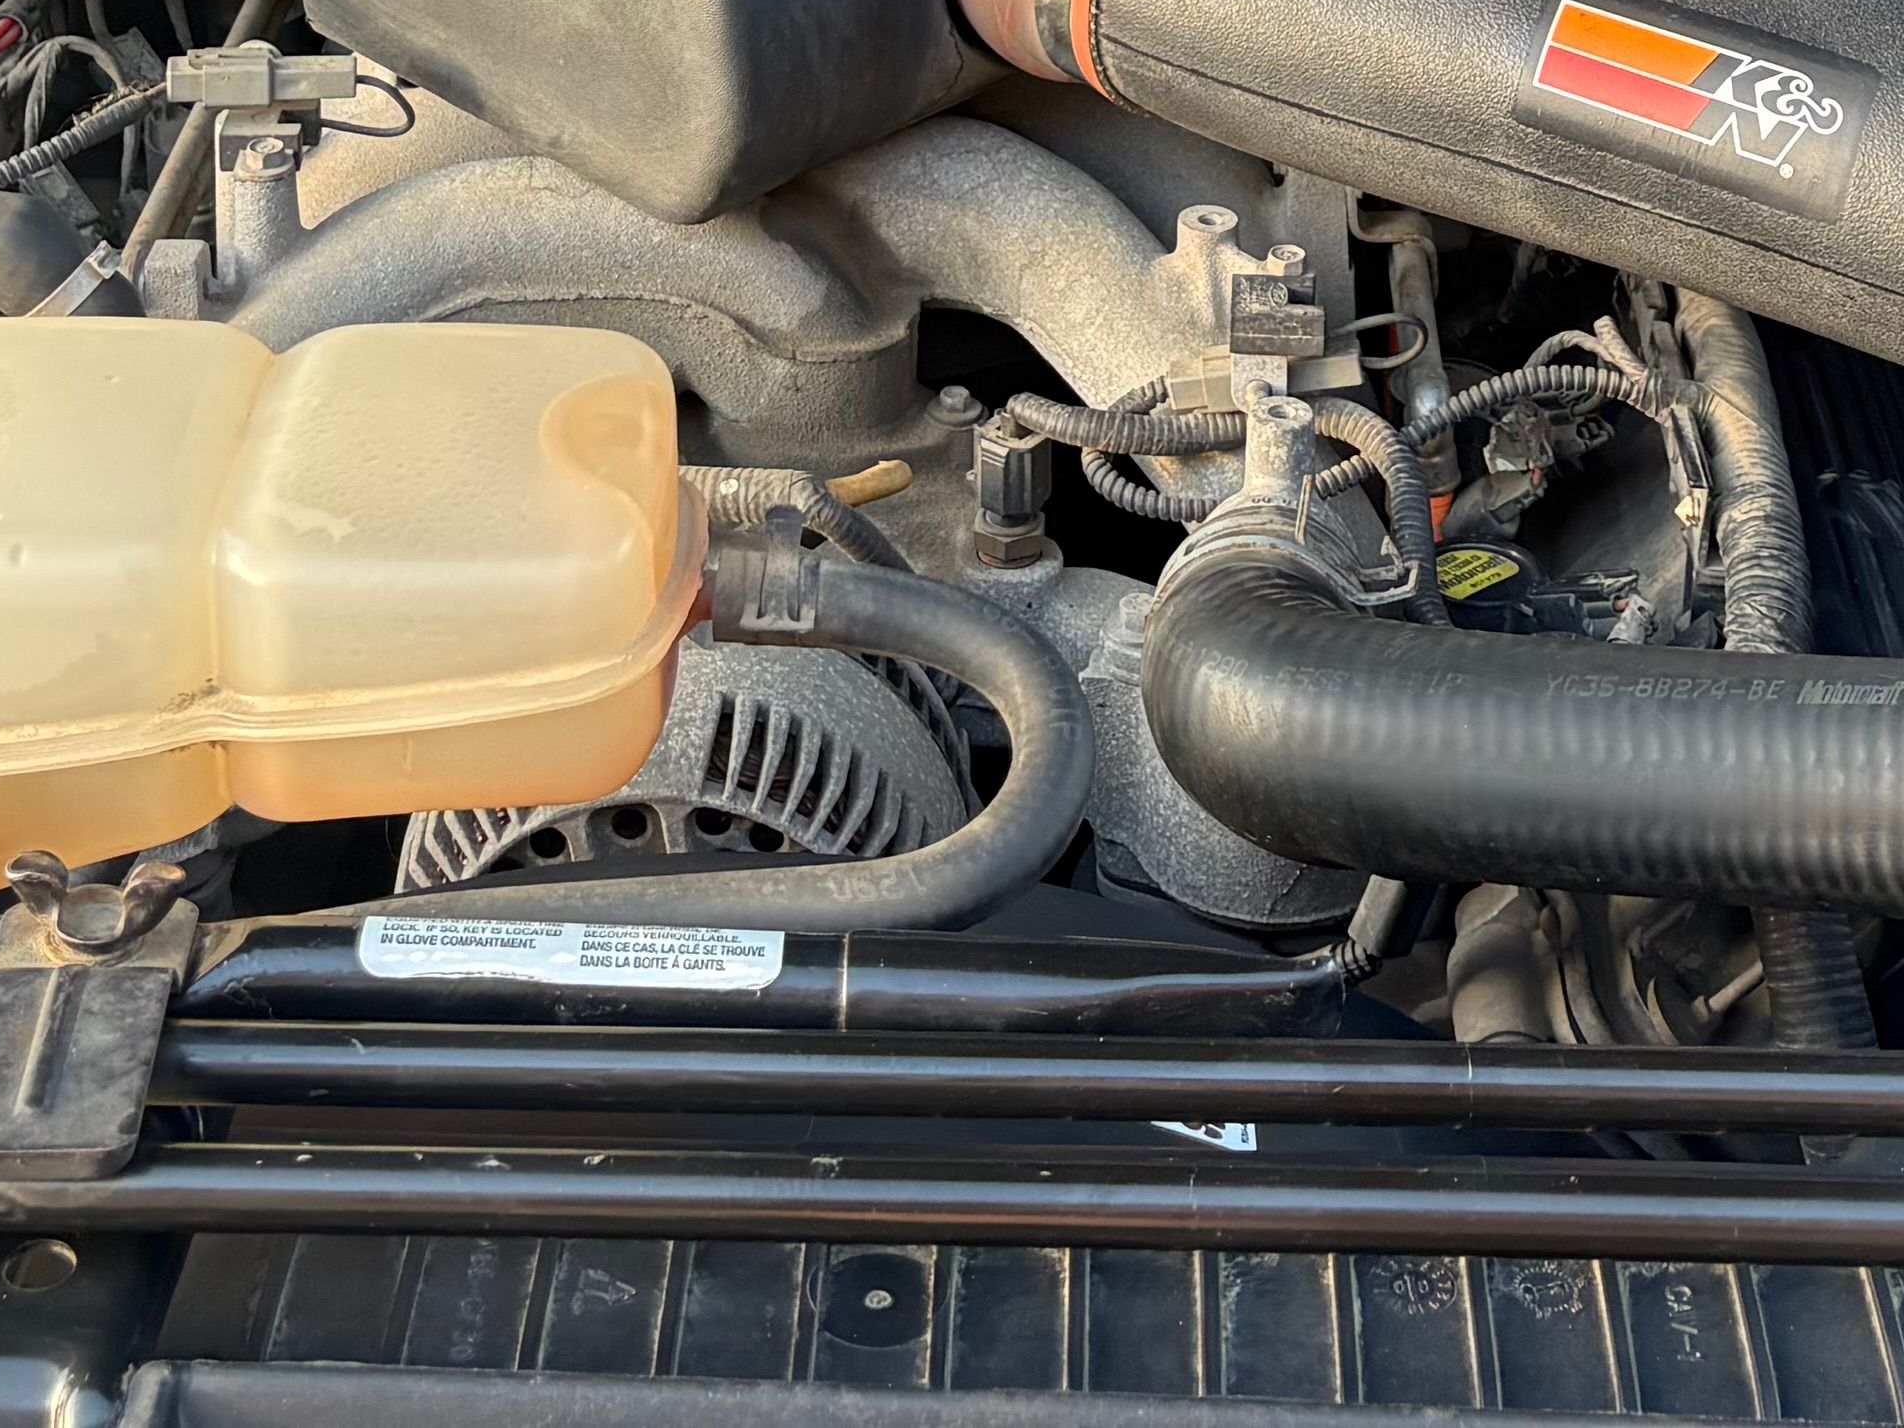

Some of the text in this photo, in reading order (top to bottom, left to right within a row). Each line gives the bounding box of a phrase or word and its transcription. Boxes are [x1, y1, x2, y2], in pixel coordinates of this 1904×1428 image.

[462, 924, 487, 935] KEY
[505, 926, 563, 937] LOCATED
[380, 933, 394, 944] IN
[395, 933, 438, 945] GLOVE
[581, 940, 613, 952] DANS
[614, 942, 631, 953] CE
[632, 943, 659, 955] CAS,
[660, 944, 676, 955] LA
[702, 945, 718, 956] SE
[720, 946, 766, 958] TROUVE
[579, 955, 613, 968] DANS
[614, 956, 631, 968] LA
[683, 959, 726, 972] GANTS.
